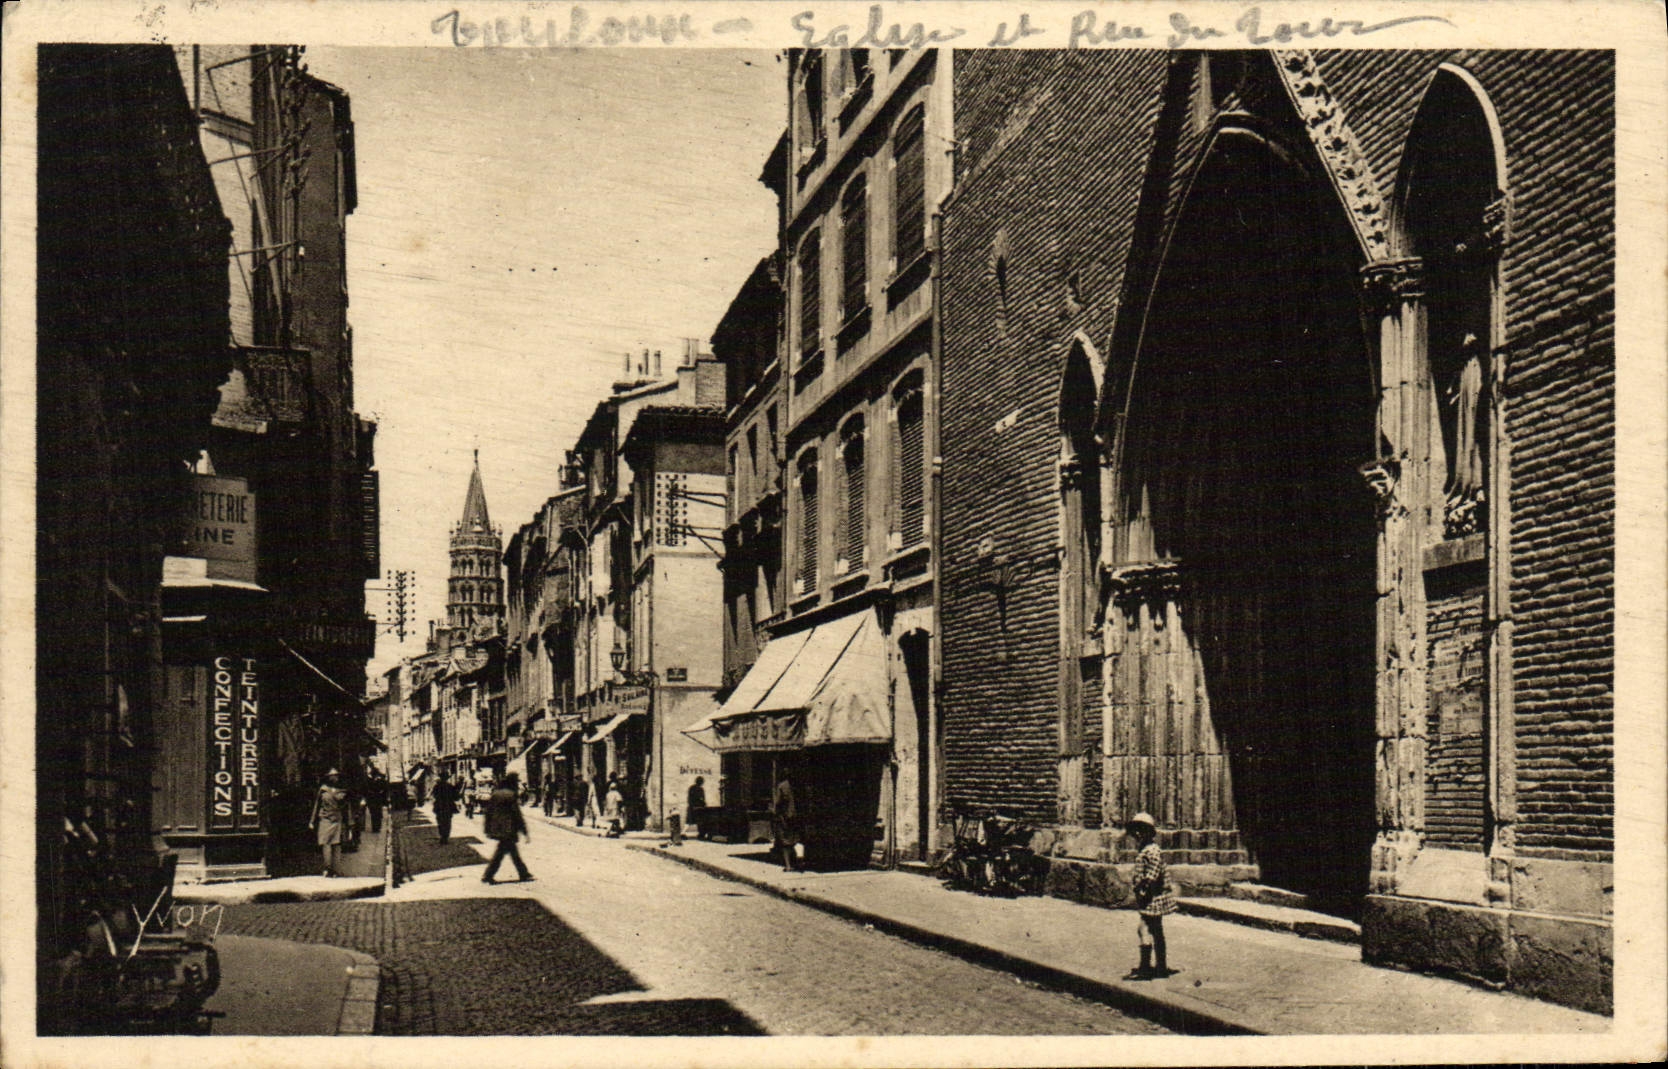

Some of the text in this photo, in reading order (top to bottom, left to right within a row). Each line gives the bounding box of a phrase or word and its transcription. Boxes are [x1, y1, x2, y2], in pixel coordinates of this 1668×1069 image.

[988, 13, 1046, 47] et
[1167, 12, 1227, 48] du
[214, 656, 232, 816] CONFECTIONS
[241, 657, 258, 815] TEINTURERIE
